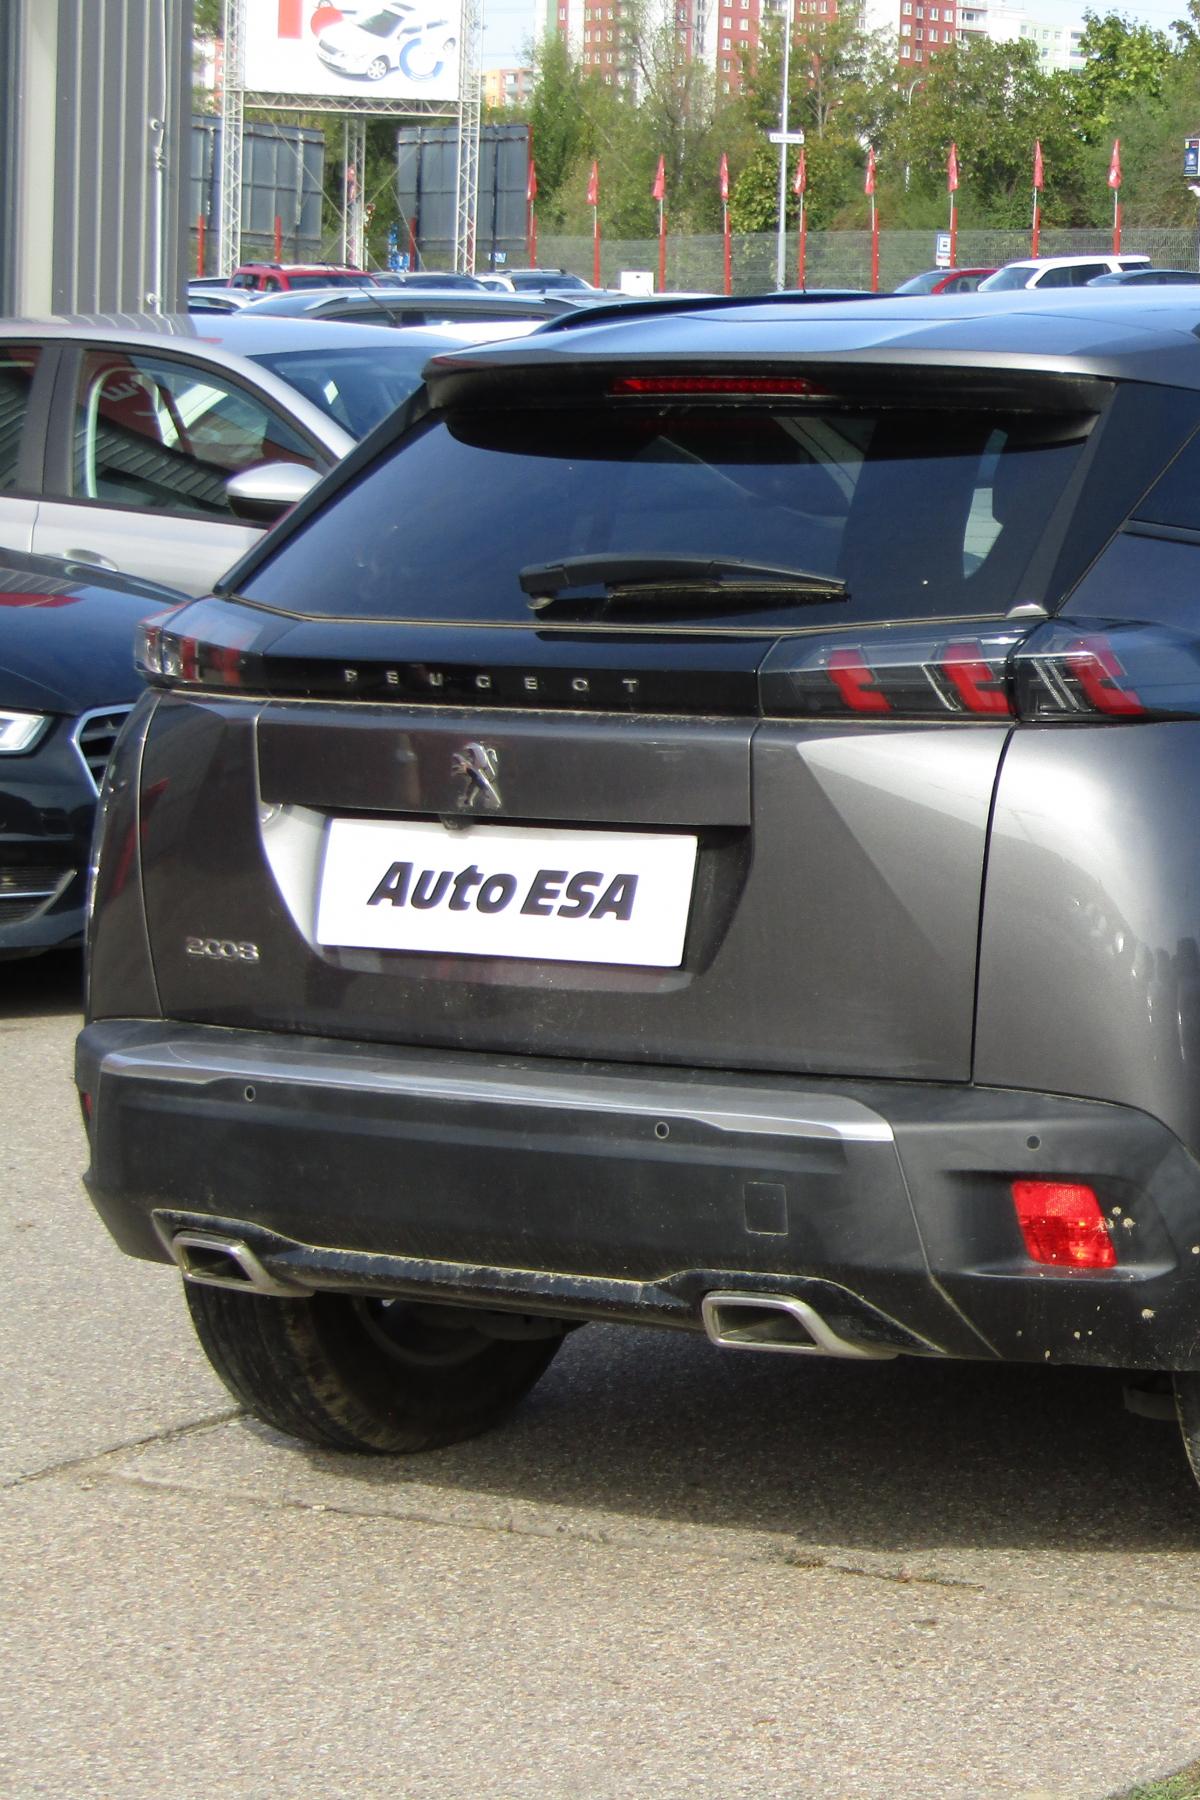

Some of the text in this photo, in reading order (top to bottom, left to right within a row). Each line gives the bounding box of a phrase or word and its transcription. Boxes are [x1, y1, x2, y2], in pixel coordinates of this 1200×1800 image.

[344, 668, 639, 693] PEUGEOT
[366, 861, 640, 921] Auto ESA
[185, 936, 260, 963] 2008
